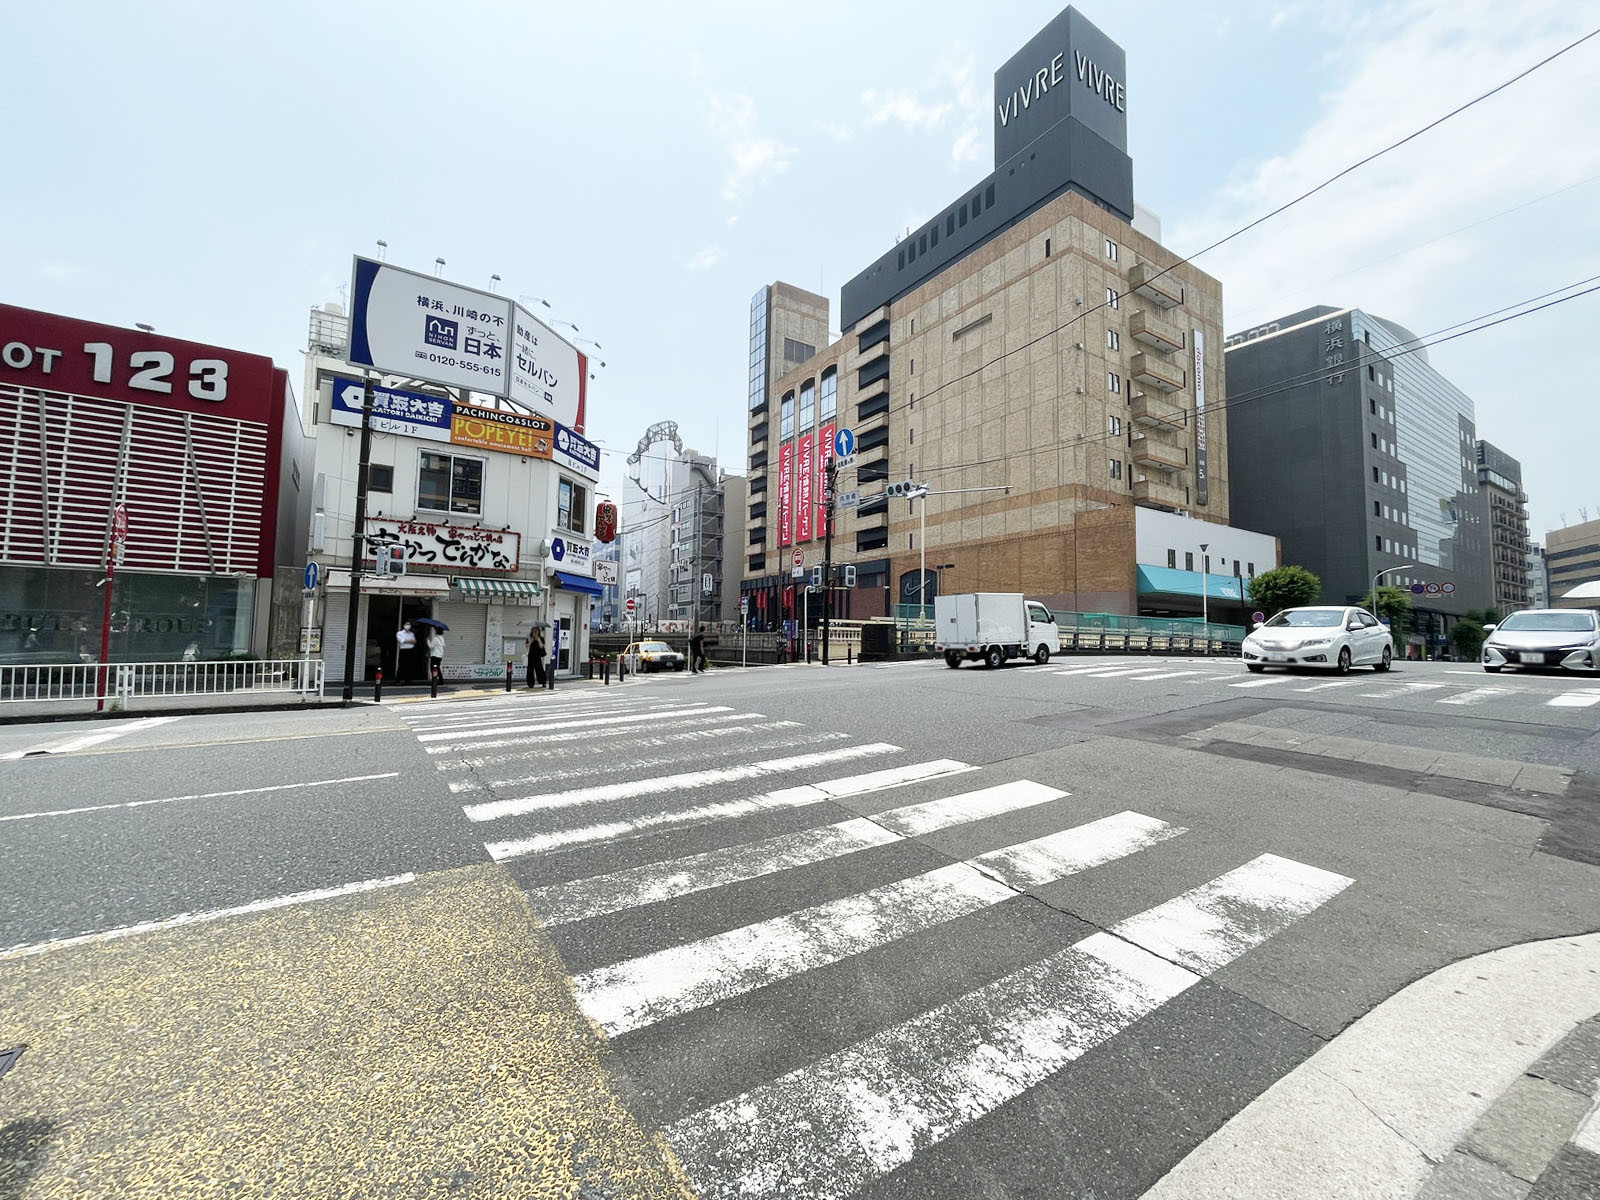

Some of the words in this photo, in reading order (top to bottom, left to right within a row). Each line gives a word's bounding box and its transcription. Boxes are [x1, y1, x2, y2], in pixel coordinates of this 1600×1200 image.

[998, 50, 1065, 127] VIVRE
[1075, 49, 1125, 113] VIVRE
[416, 295, 504, 327] 横浜、川崎の不
[428, 332, 454, 342] NIHON
[428, 337, 454, 347] SERVAN
[464, 337, 503, 359] 日本
[429, 353, 501, 377] 0120-555-615
[1324, 320, 1344, 385] 横浜銀行
[84, 342, 229, 401] 123
[517, 353, 558, 388] セルバン
[372, 390, 444, 418] 買取大吉
[405, 412, 438, 423] DAIKICHI
[456, 405, 546, 430] PACHINCO&SLOT
[454, 418, 533, 447] POPEYE!
